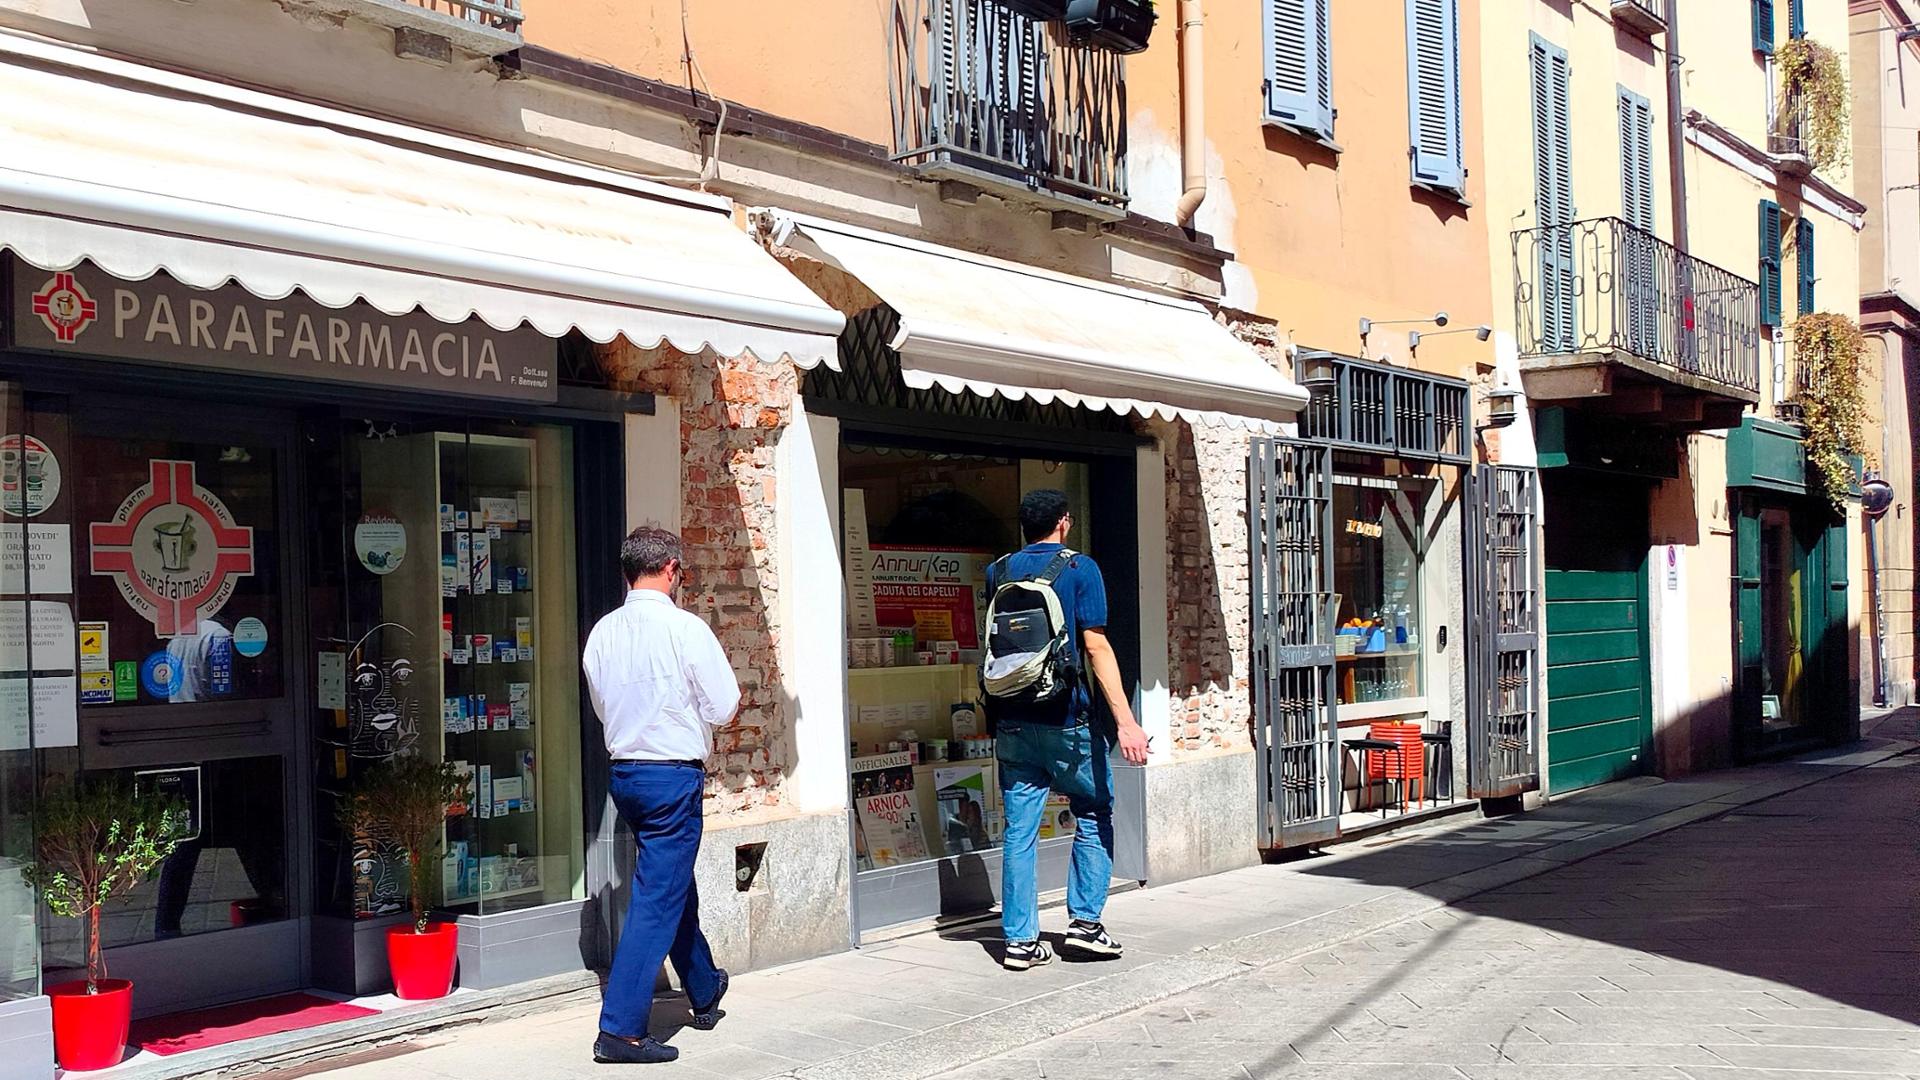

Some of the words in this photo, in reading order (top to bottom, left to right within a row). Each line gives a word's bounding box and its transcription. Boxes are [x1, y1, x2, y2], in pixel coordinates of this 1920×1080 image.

[115, 288, 502, 382] PARAFARMACIA
[118, 488, 146, 522] pharm
[201, 492, 228, 521] natur
[122, 581, 149, 611] natur
[141, 569, 211, 600] parafarmacia
[205, 581, 231, 612] pharm
[872, 584, 905, 597] CADUTA
[907, 585, 920, 597] DEI
[922, 586, 961, 597] CAPELLI?
[80, 689, 112, 697] ANCOMAT
[855, 755, 908, 771] OFFICINALIS
[867, 793, 911, 814] ARNICA
